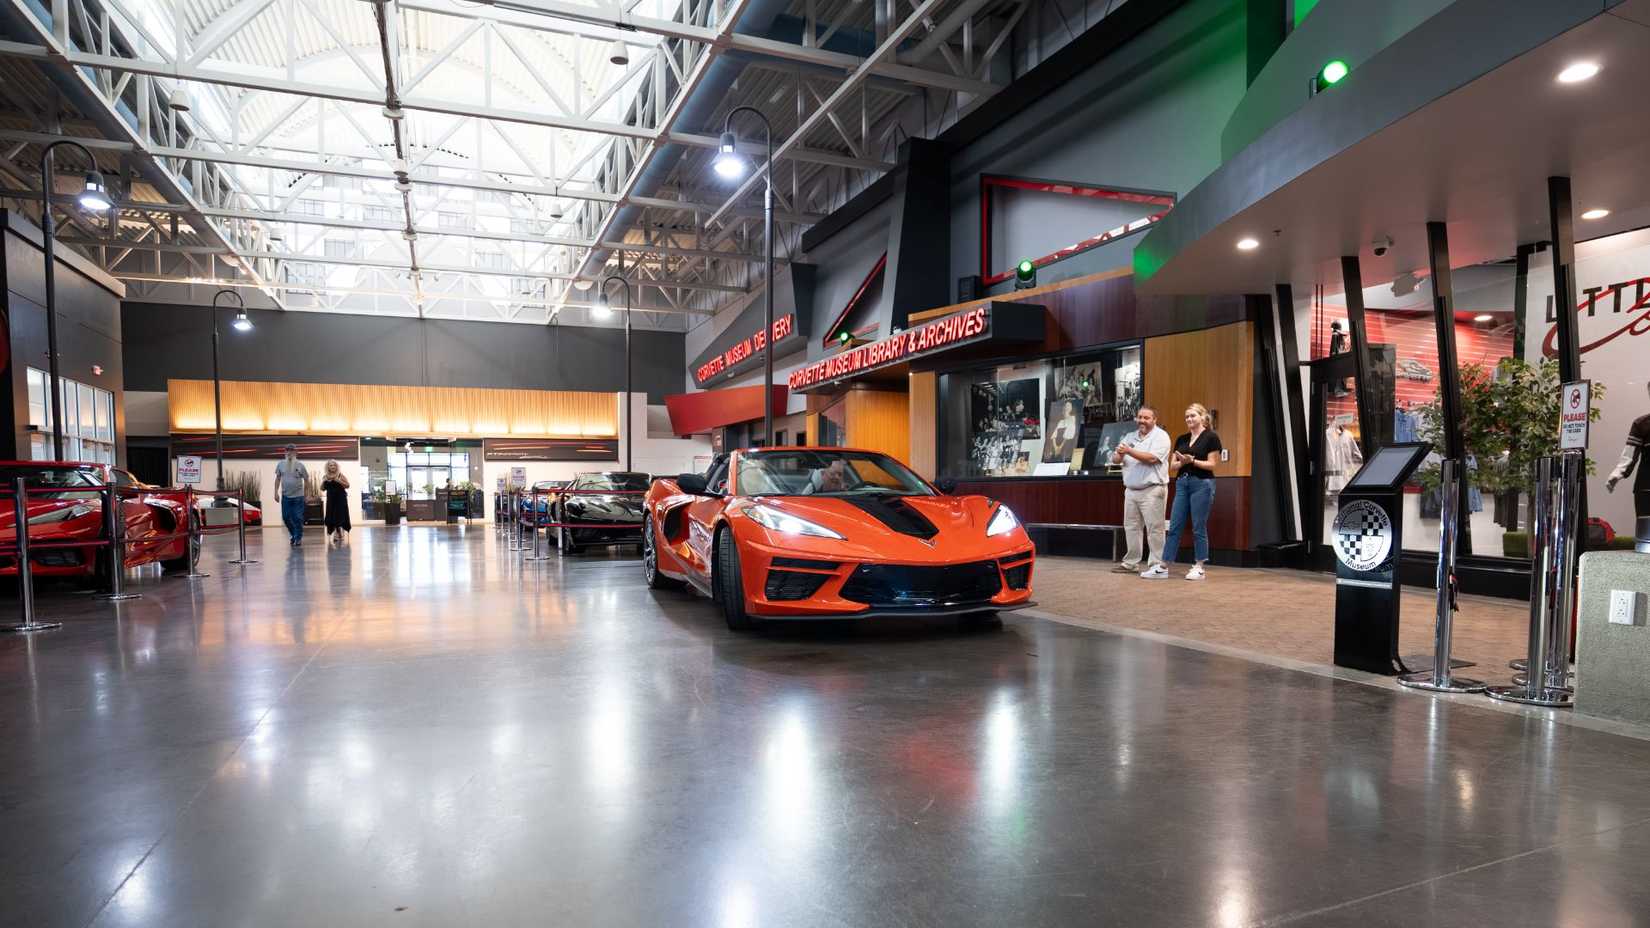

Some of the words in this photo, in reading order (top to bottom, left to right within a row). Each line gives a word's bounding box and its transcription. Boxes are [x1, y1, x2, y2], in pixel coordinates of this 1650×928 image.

[698, 355, 724, 382] CORVETTE
[725, 338, 752, 366] MUSEUM
[754, 314, 791, 351] DEERY
[788, 363, 825, 389] CORVETTE
[825, 350, 862, 378] MUSEUM
[863, 334, 906, 368] LIBRARY
[908, 331, 916, 352] &
[918, 308, 985, 350] ARCHIVES
[1563, 413, 1585, 421] PLEASE
[1345, 558, 1376, 570] Museum
